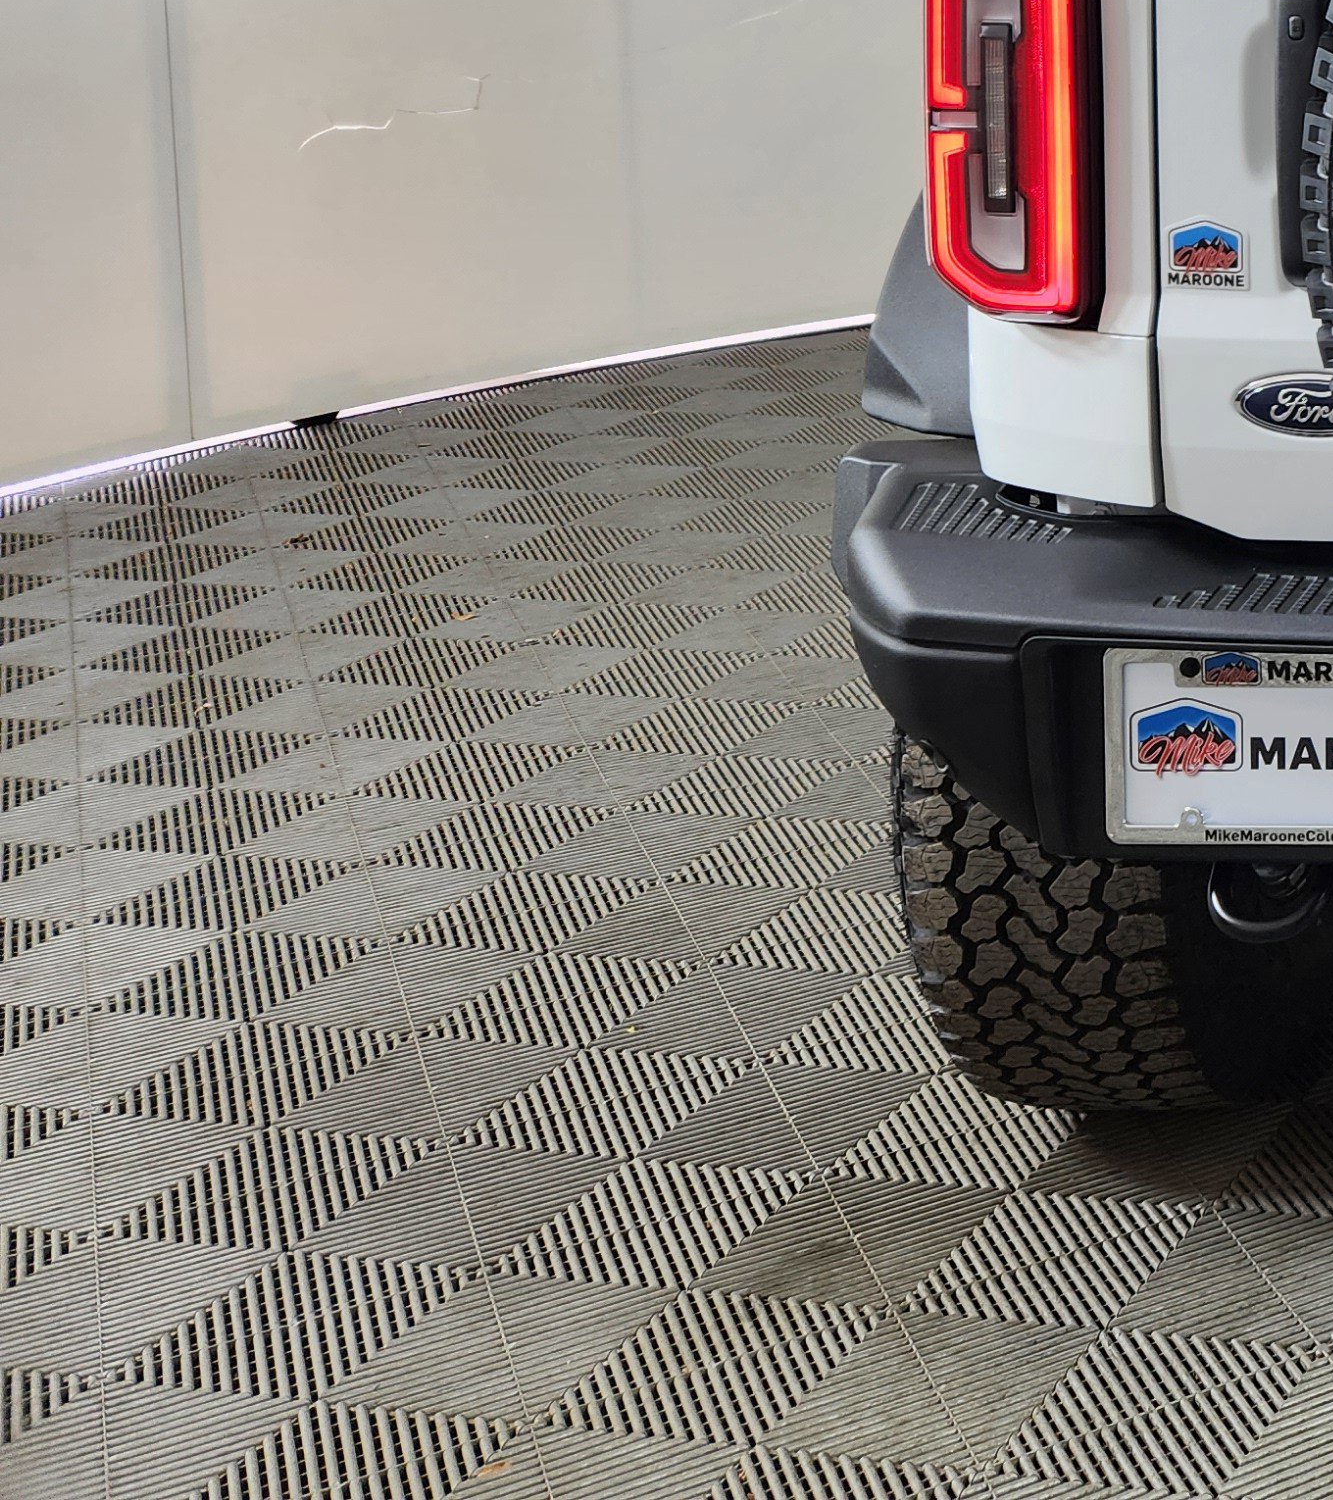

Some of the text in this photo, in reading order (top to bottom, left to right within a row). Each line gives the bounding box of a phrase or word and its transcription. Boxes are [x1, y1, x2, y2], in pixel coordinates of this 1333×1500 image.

[1175, 243, 1237, 274] Mike
[1168, 272, 1245, 287] MAROONE
[1138, 730, 1236, 780] Mike
